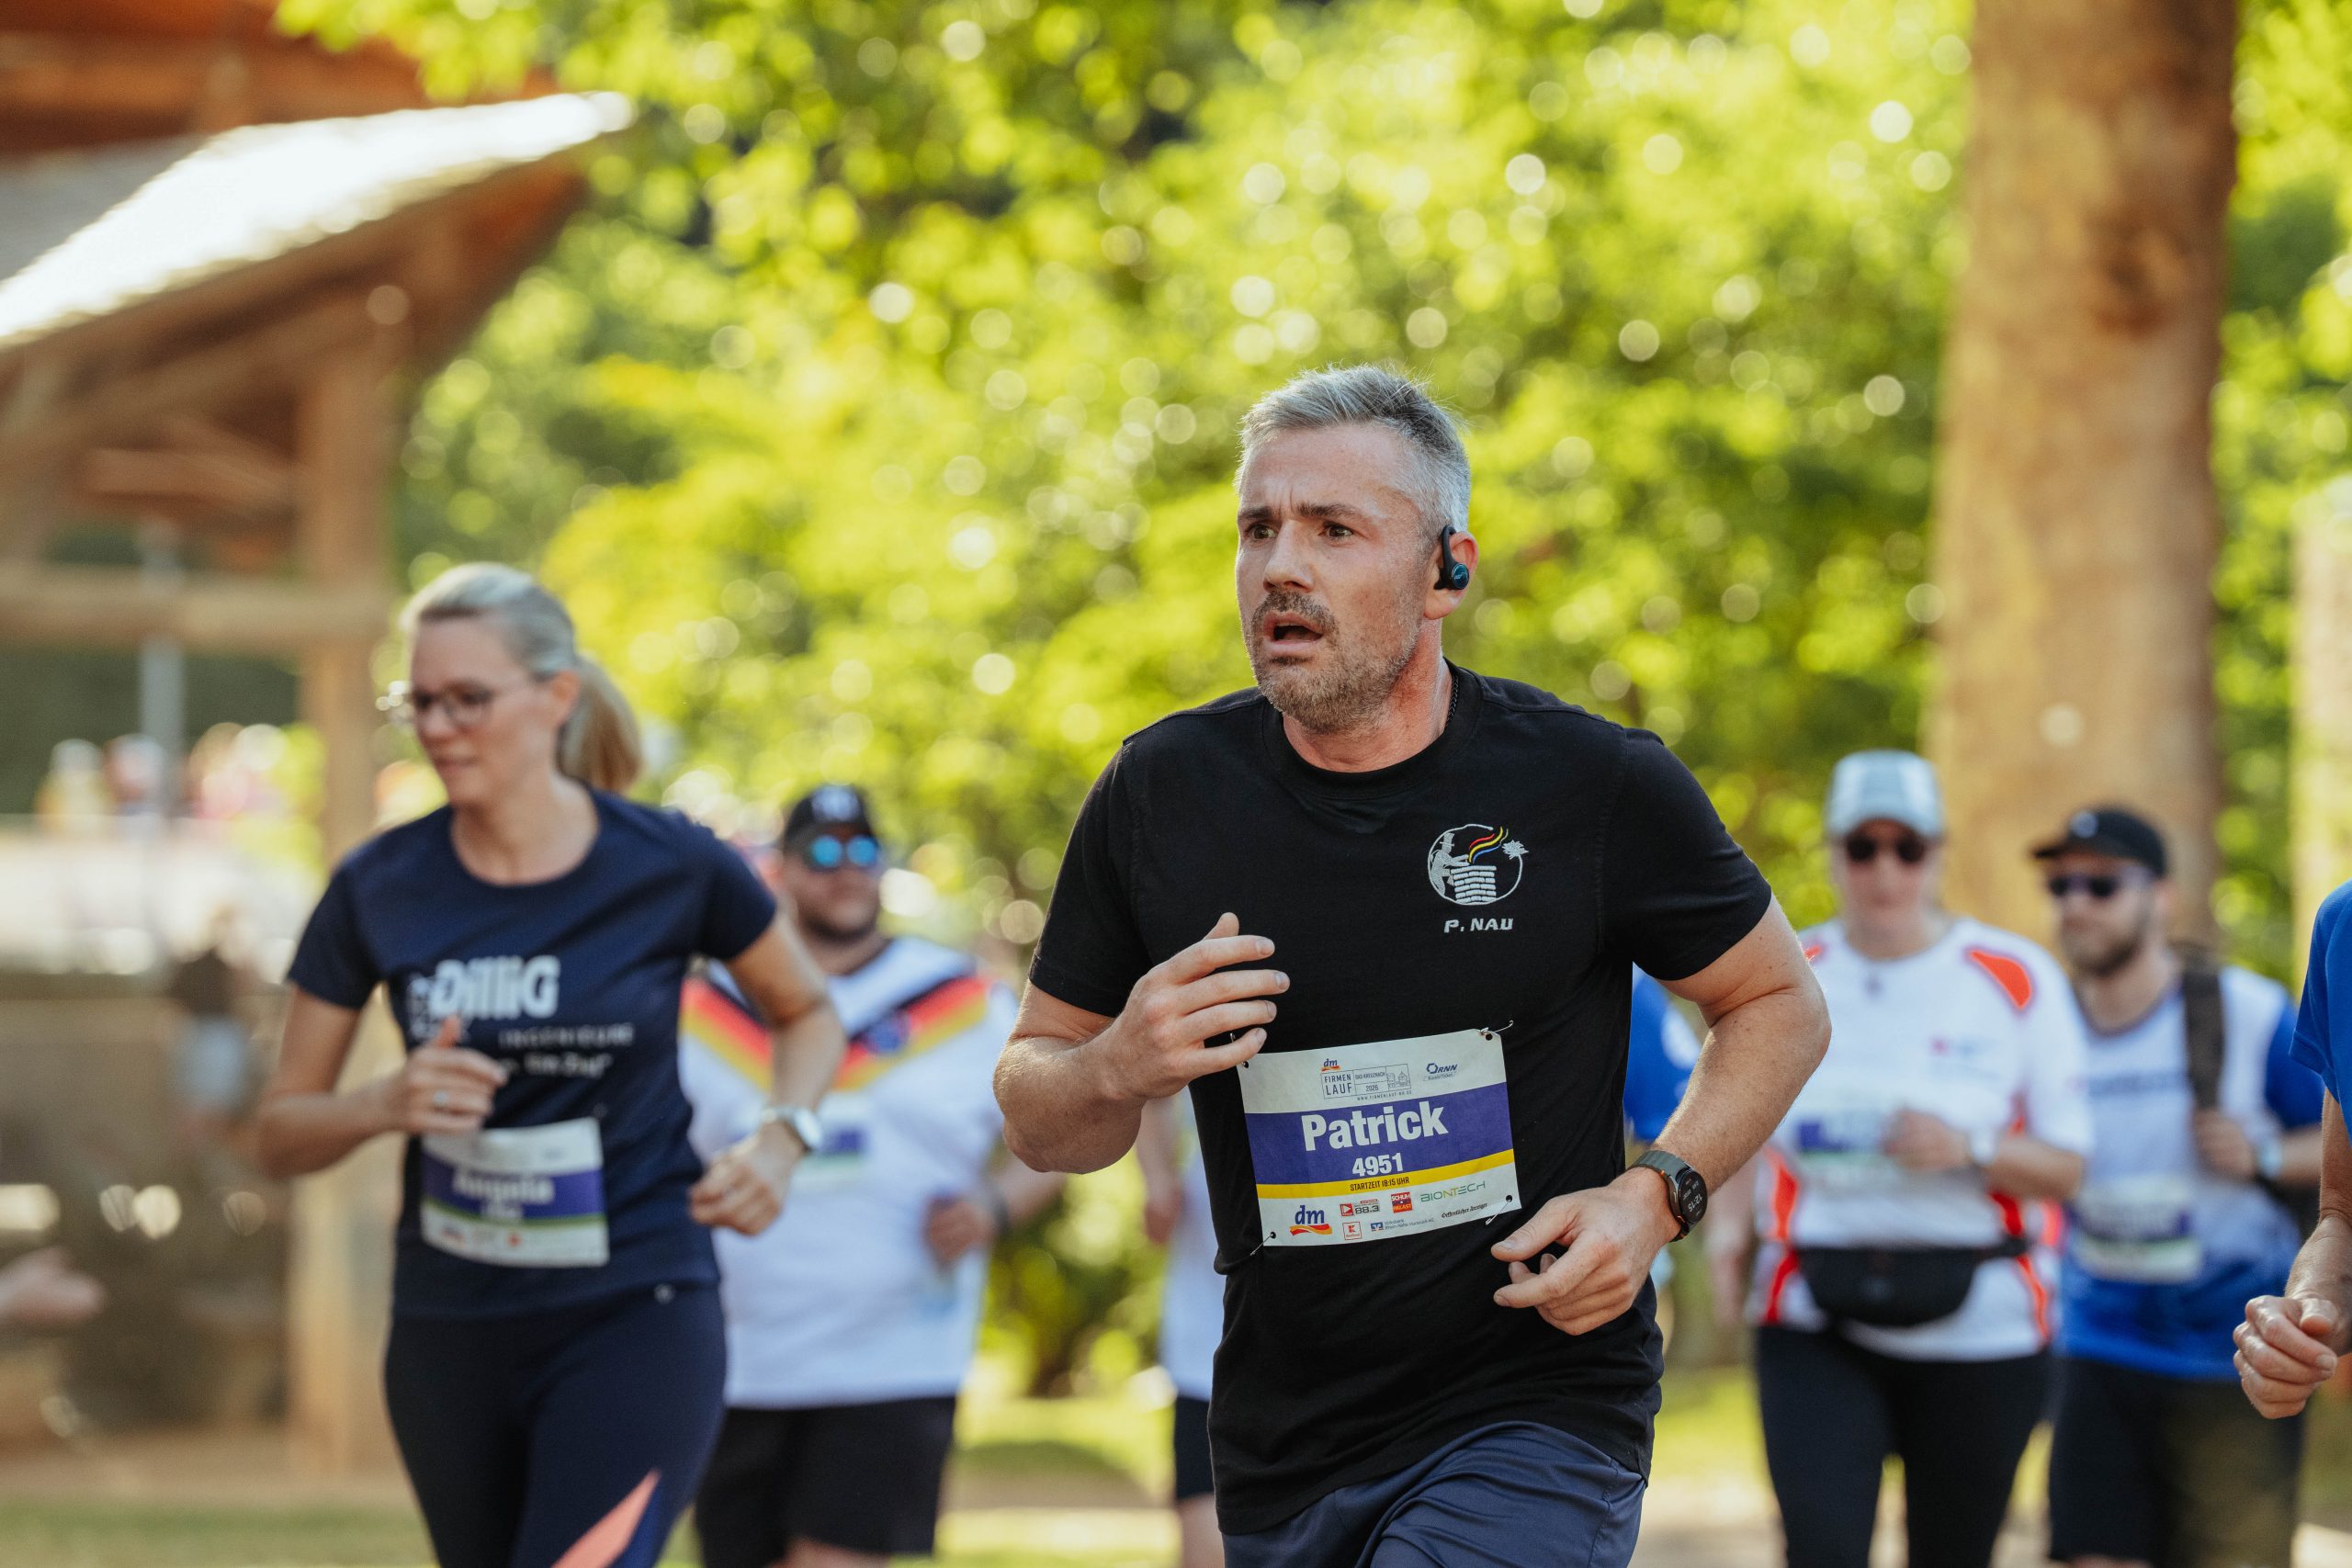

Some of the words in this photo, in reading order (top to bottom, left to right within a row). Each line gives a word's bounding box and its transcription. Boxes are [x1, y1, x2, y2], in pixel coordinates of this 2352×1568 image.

[1443, 919, 1464, 933] P.
[1469, 918, 1514, 931] NAU
[1323, 1058, 1338, 1067] dm
[1324, 1073, 1351, 1083] FIRMEN
[1325, 1082, 1352, 1095] LAUF
[1301, 1100, 1449, 1152] Patrick
[1351, 1152, 1404, 1177] 4951
[1350, 1180, 1381, 1191] STARTZEIT
[1381, 1178, 1396, 1187] 18:15
[1396, 1176, 1410, 1185] UHR
[1419, 1180, 1486, 1202] BIONTECH
[1294, 1204, 1326, 1225] dm
[1354, 1205, 1380, 1214] 88.3
